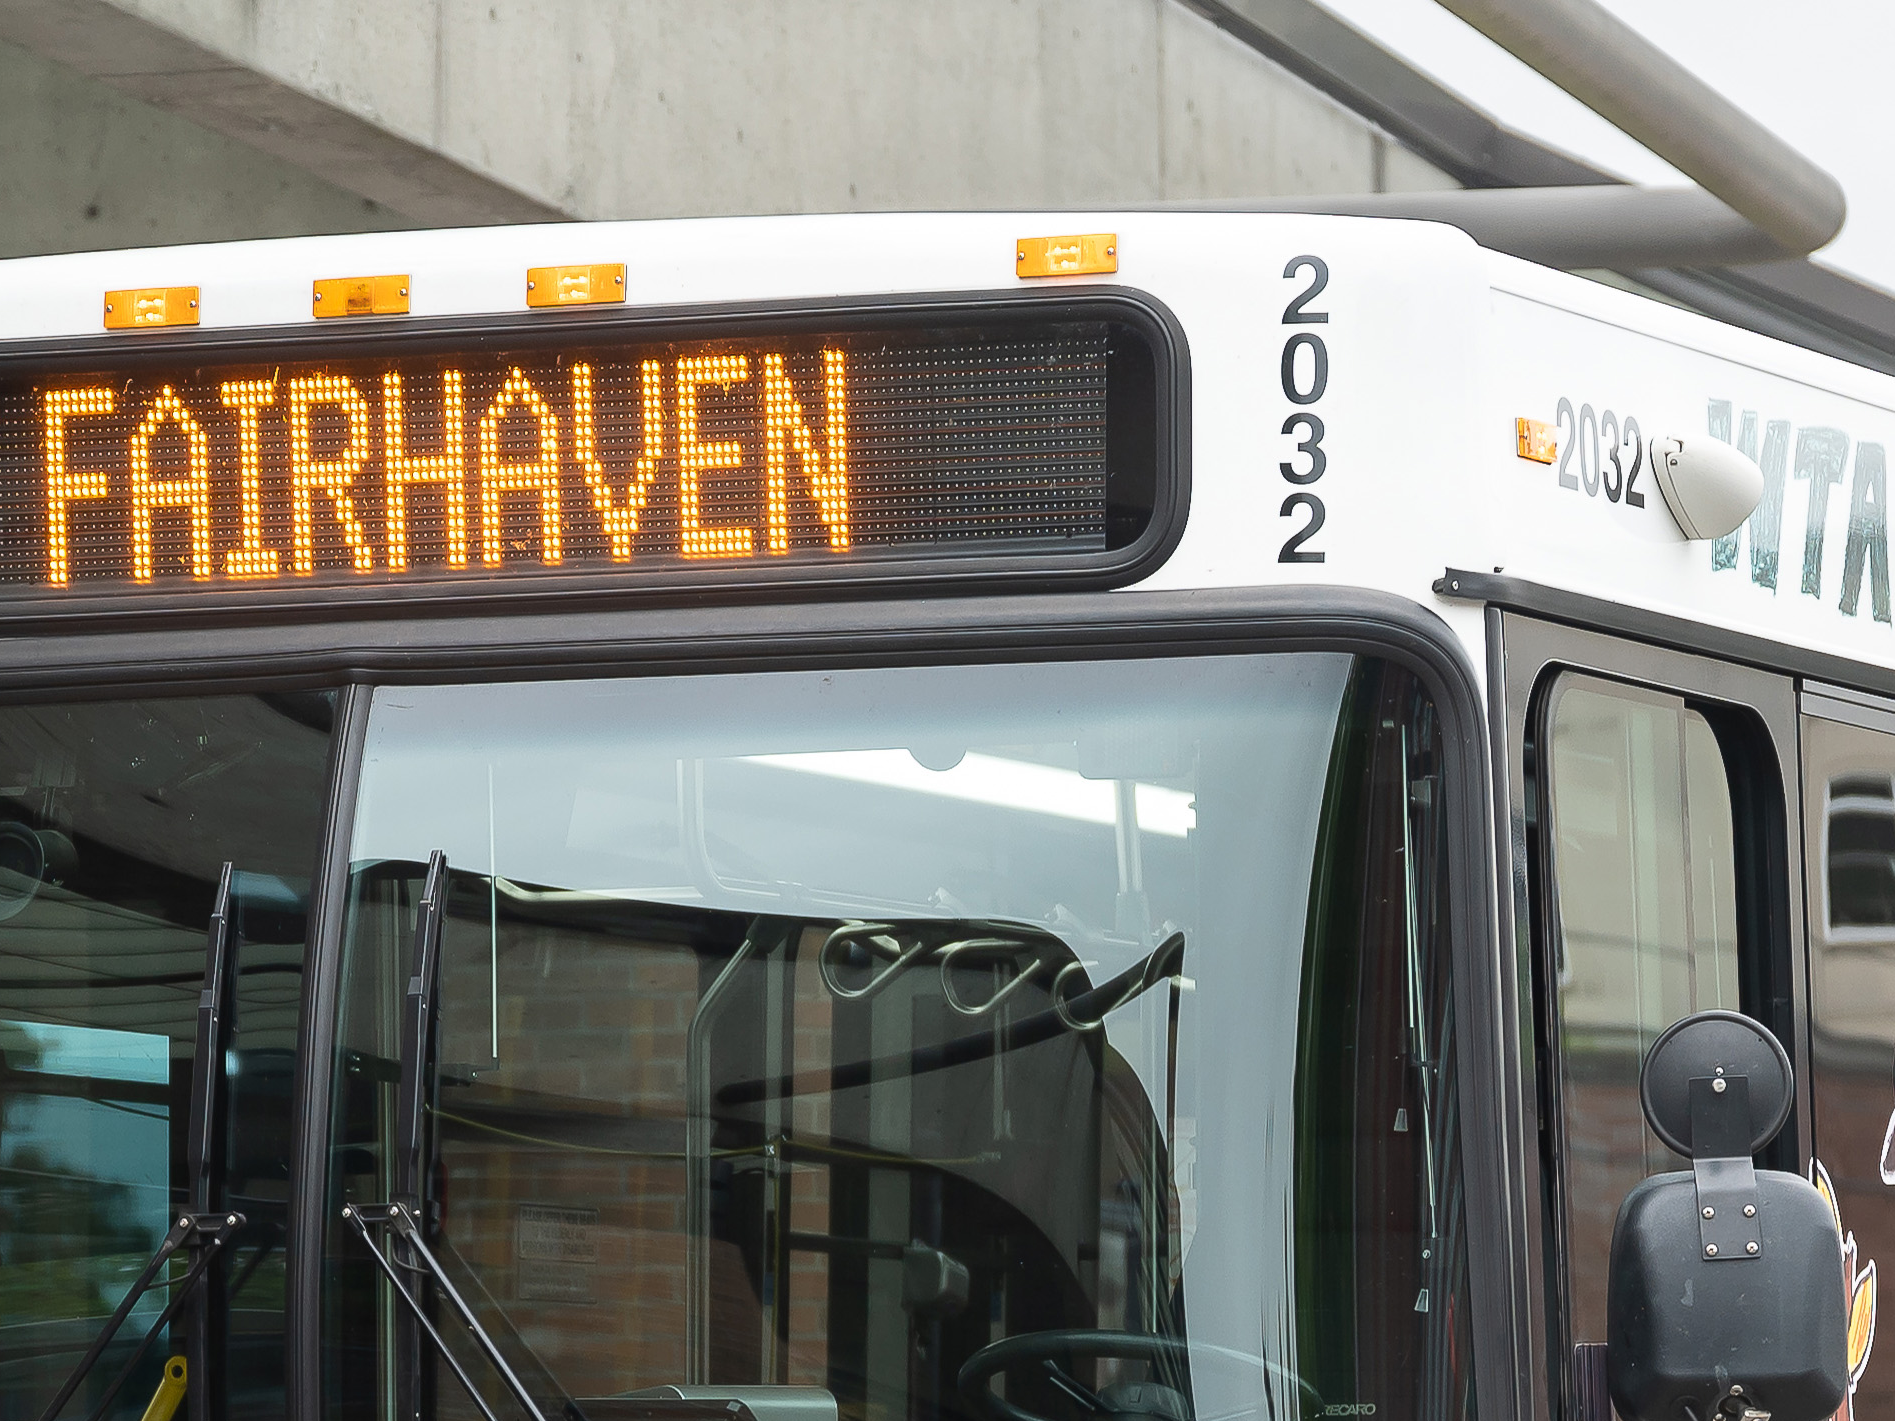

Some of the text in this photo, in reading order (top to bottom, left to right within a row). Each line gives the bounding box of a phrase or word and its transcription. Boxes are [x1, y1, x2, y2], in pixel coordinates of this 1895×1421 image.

[41, 347, 851, 590] FAIRHAVEN
[1277, 254, 1329, 565] 2032
[1556, 397, 1646, 510] 2032
[1707, 398, 1892, 627] WTA
